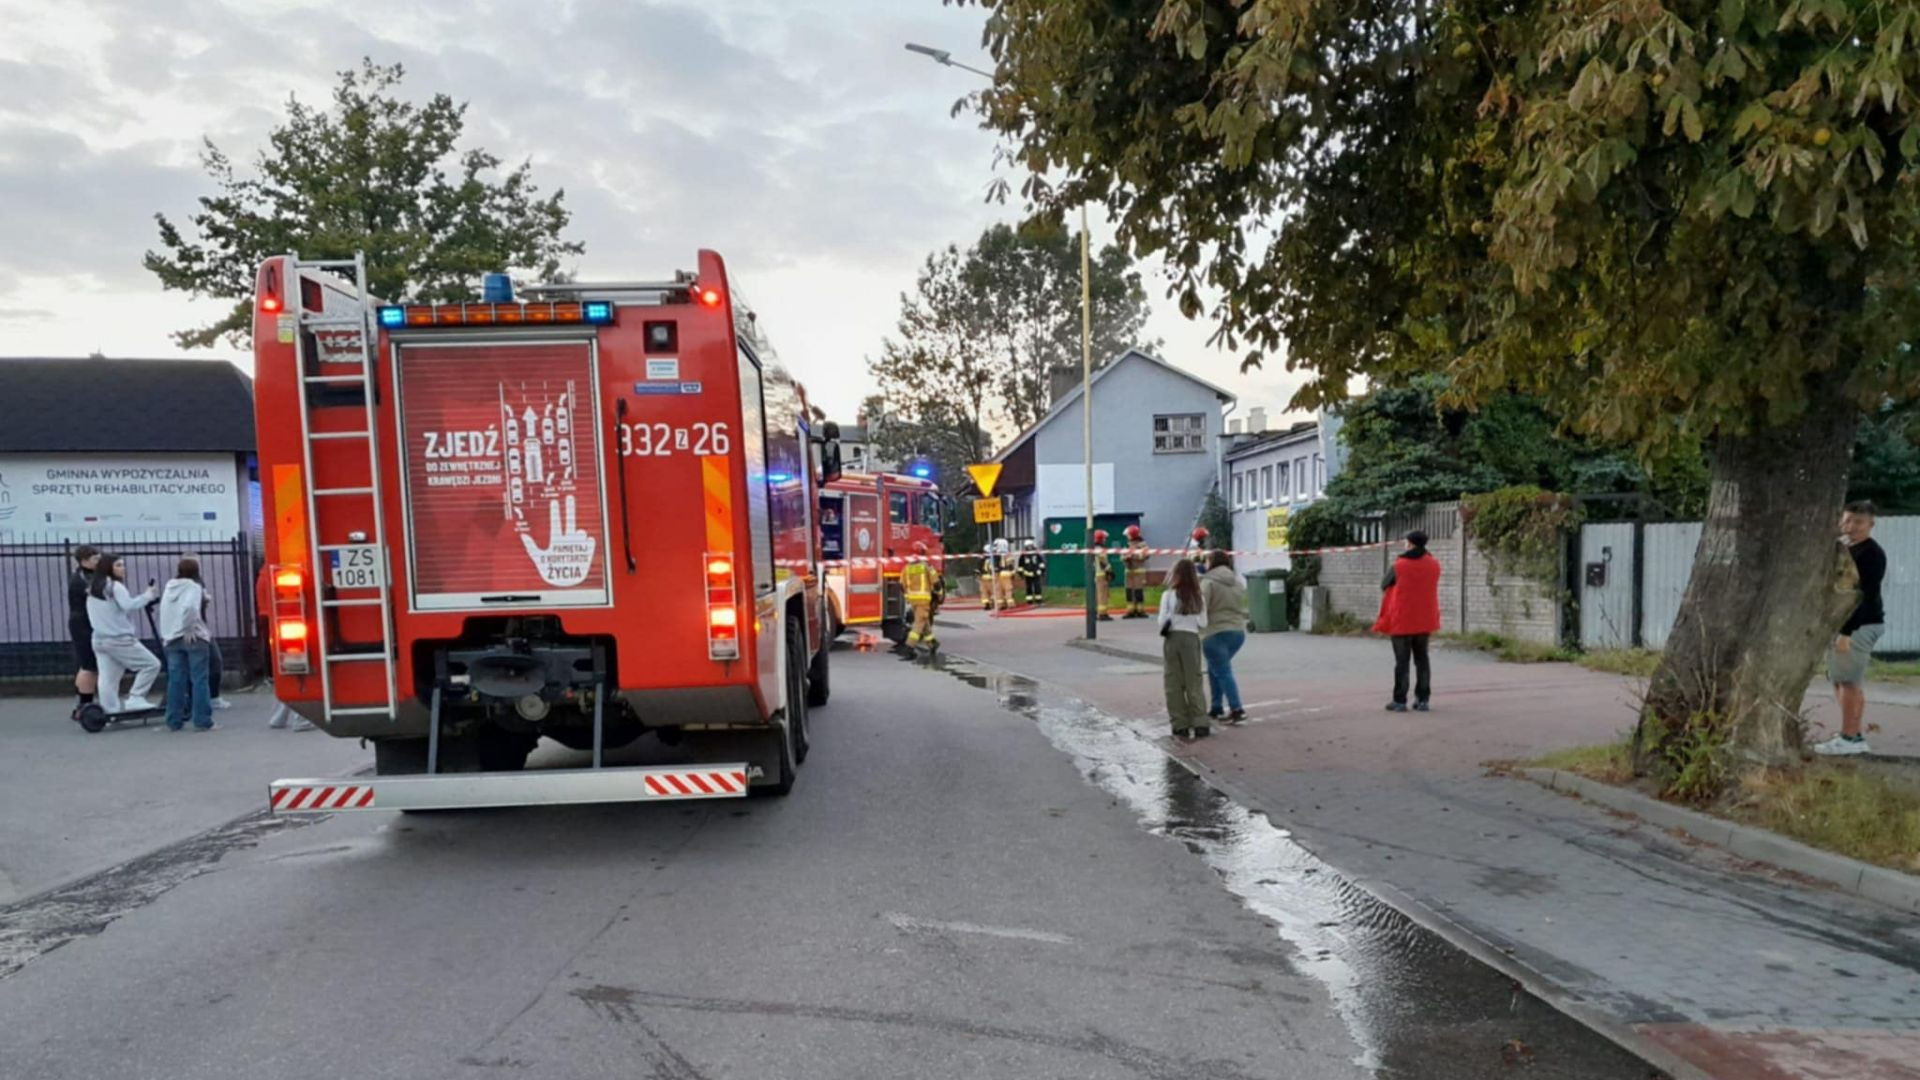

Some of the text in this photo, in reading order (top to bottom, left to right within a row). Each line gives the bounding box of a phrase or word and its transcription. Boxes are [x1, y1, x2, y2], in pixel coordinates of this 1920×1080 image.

[423, 424, 500, 459] ZJEDŹ
[692, 422, 729, 455] 26
[46, 467, 210, 480] GMINNA WYPOŻYCZALNIA
[32, 483, 226, 497] SPRZĘTU REHABILITACYJNEGO
[347, 549, 374, 567] ZS
[336, 569, 375, 586] 1081
[547, 563, 582, 579] ŻYCIA
